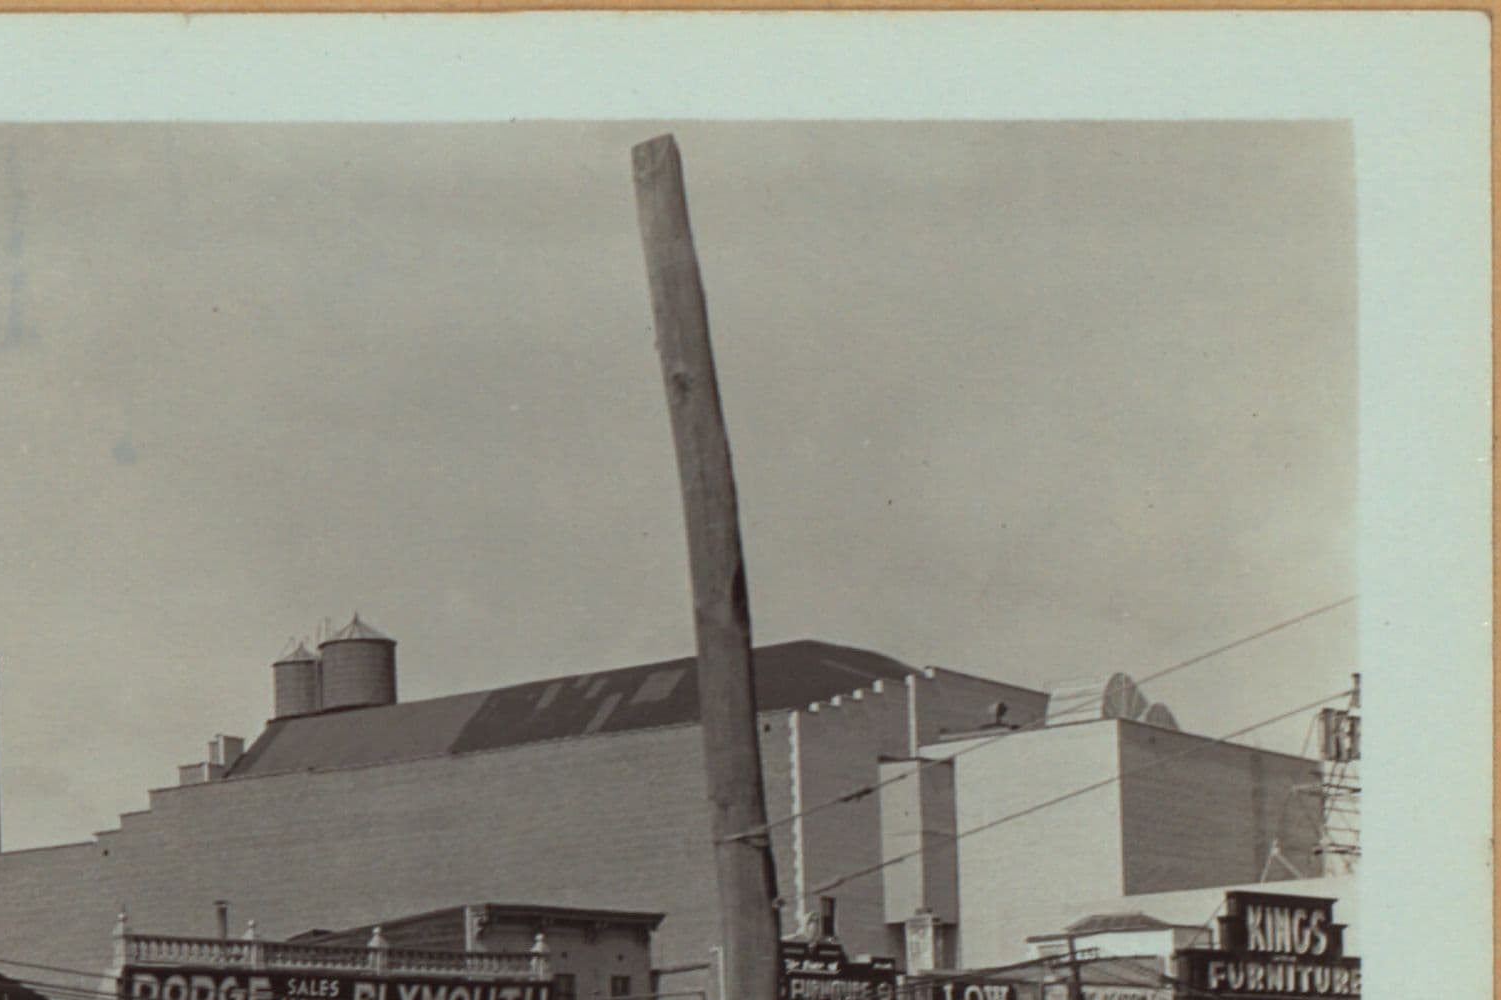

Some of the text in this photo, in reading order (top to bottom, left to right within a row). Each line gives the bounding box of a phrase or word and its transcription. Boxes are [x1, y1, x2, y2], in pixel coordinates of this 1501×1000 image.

[1246, 904, 1327, 955] KINGS
[287, 979, 339, 996] SALES
[1208, 961, 1361, 995] FURNITURE
